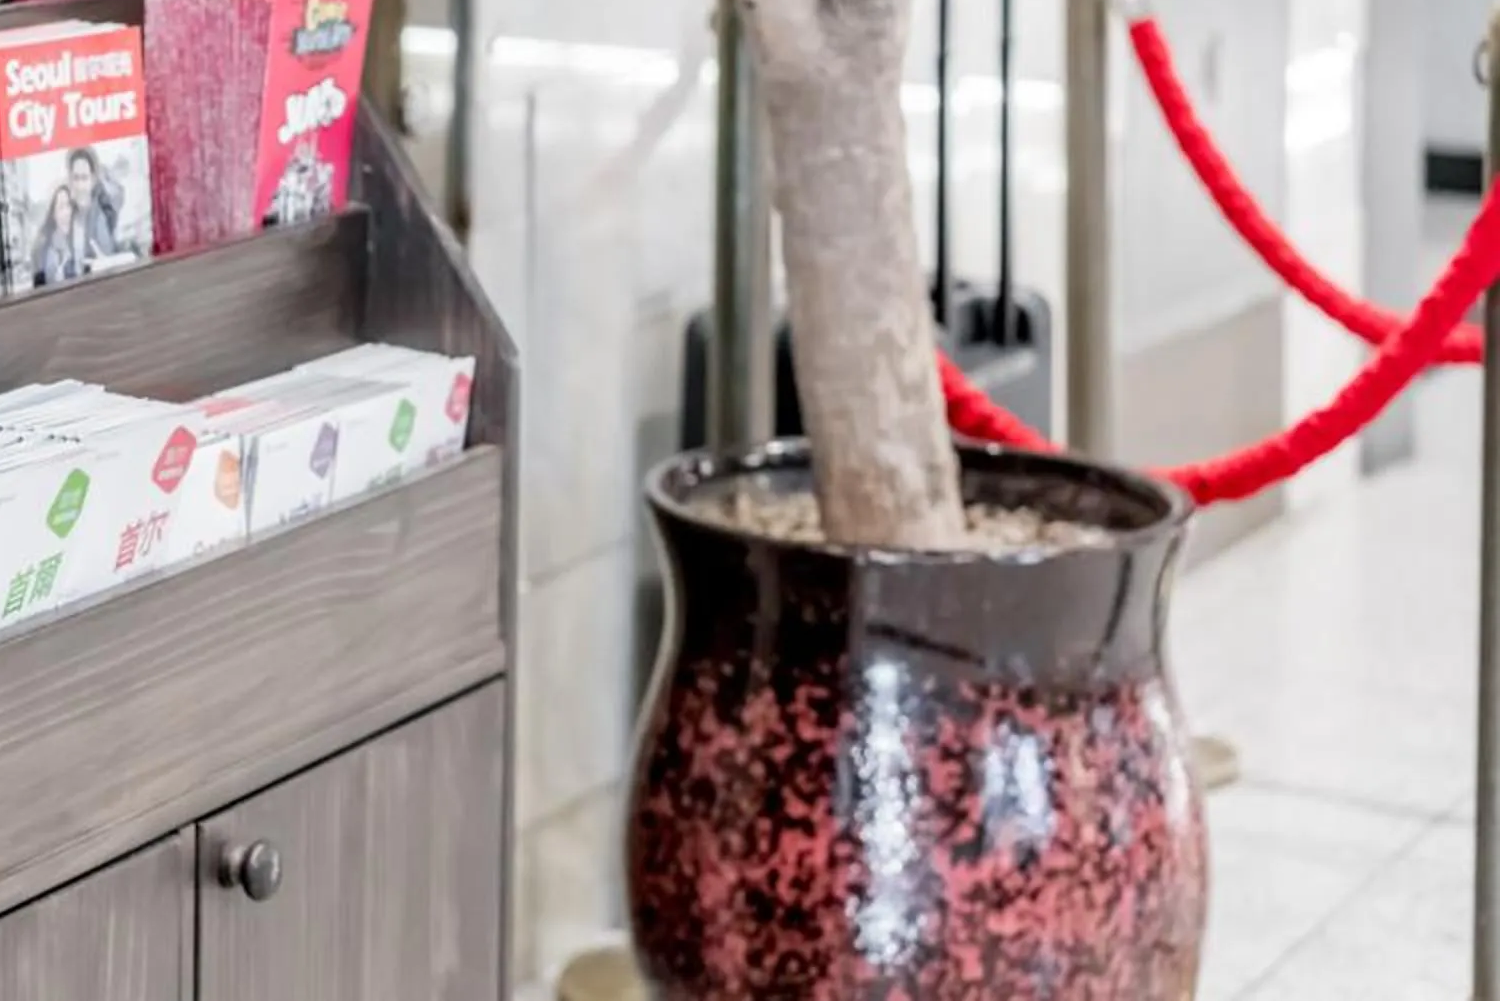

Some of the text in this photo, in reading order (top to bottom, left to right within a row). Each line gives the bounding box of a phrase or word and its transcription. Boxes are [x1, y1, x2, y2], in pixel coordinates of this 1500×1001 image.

[5, 51, 72, 96] Seoul
[8, 90, 137, 146] City Tours
[114, 510, 171, 572] 首尔
